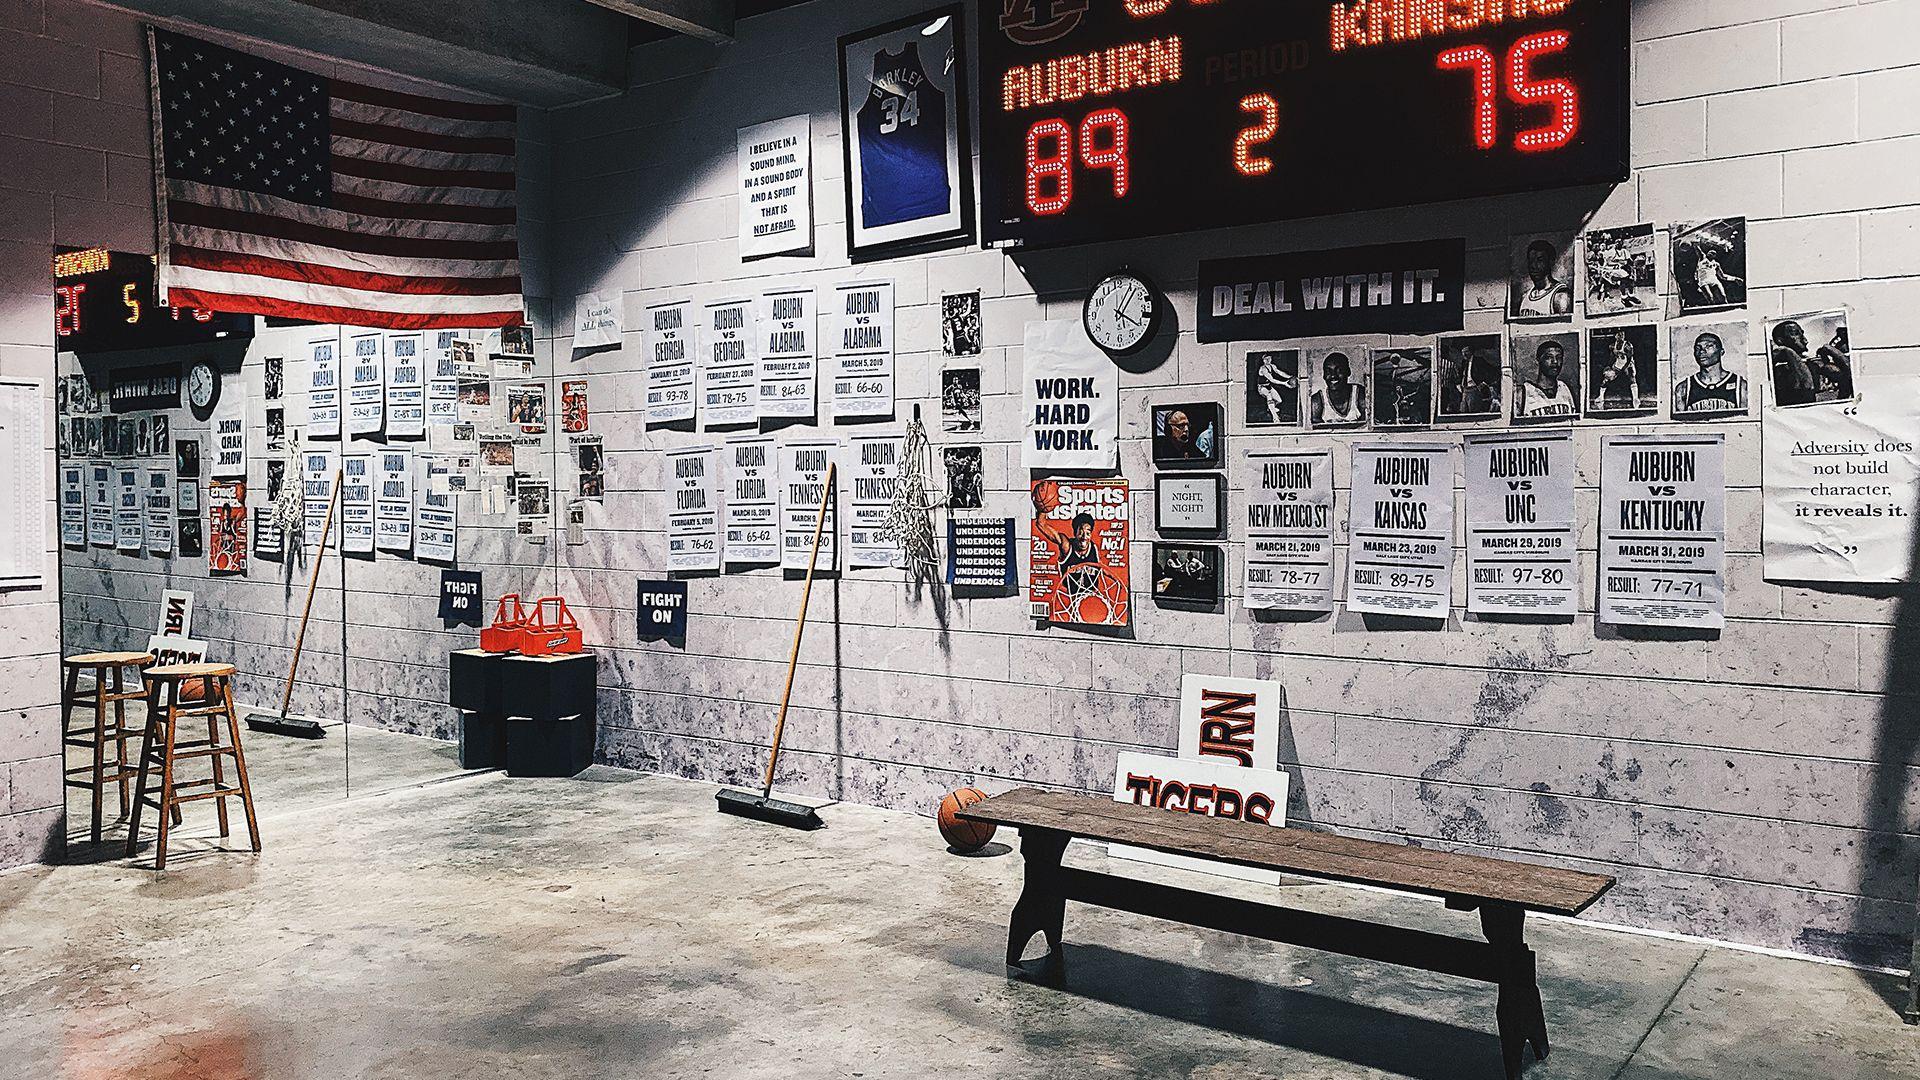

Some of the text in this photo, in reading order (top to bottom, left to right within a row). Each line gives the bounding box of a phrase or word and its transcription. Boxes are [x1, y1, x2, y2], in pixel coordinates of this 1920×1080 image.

[872, 67, 924, 99] BARKLEY
[1002, 35, 1182, 111] AUBURN
[1436, 30, 1579, 153] 75
[880, 90, 920, 134] 34
[1233, 92, 1279, 176] 2
[753, 140, 782, 155] BELIEVE
[783, 138, 791, 148] IN
[792, 136, 798, 146] A
[750, 158, 775, 171] SOUND
[1026, 107, 1130, 215] 89
[745, 178, 752, 188] IN
[760, 173, 785, 186] SOUND
[785, 168, 804, 180] BODY
[751, 192, 766, 203] AND
[774, 186, 796, 199] SPIRIT
[761, 204, 788, 217] THAT IS
[753, 219, 796, 235] NOT AFRAID.
[846, 291, 880, 315] AUBURN
[1212, 268, 1445, 317] DEAL WITH IT.
[714, 307, 743, 330] AUBURN
[772, 297, 803, 320] AUBURN
[655, 308, 682, 331] AUBURN
[769, 331, 805, 353] ALABAMA
[843, 326, 882, 349] ALABAMA
[655, 339, 685, 362] GEORGIA
[713, 340, 745, 363] GEORGIA
[797, 361, 810, 369] 2019
[842, 358, 883, 368] MARCH 5, 2019
[856, 382, 883, 394] 66-60
[1035, 377, 1100, 400] WORK.
[1035, 404, 1090, 425] HARD
[1034, 429, 1099, 451] WORK.
[1790, 438, 1913, 457] Adversity does
[735, 446, 765, 467] AUBURN
[795, 450, 827, 471] AUBURN
[861, 443, 895, 466] AUBURN
[1489, 446, 1549, 477] AUBURN
[676, 457, 704, 479] AUBURN
[1262, 462, 1312, 489] AUBURN
[1374, 457, 1430, 486] AUBURN
[1629, 451, 1695, 482] AUBURN
[1813, 461, 1889, 475] not build
[676, 488, 706, 510] FLORIDA
[736, 478, 766, 500] FLORIDA
[1058, 485, 1125, 505] Sports
[1172, 492, 1203, 502] NIGHT,
[1810, 482, 1892, 497] character,
[791, 514, 812, 522] MARCH
[856, 510, 878, 518] MARCH
[1171, 504, 1203, 513] NIGHT!
[1248, 504, 1329, 528] NEW MEXICO ST
[1374, 501, 1427, 530] KANSAS
[1505, 493, 1536, 524] UNC
[1620, 500, 1706, 531] KENTUCKY
[1795, 504, 1908, 517] it reveals it.
[691, 539, 713, 550] 76-62
[746, 530, 770, 542] 65-62
[1034, 541, 1047, 551] 20
[1482, 537, 1562, 548] MARCH 29, 2019
[1255, 542, 1320, 552] MARCH 21, 2019
[1363, 541, 1436, 554] MARCH 23, 2019
[1619, 545, 1704, 558] MARCH 31, 2019
[953, 577, 1005, 586] UNDERDOGS
[955, 567, 1006, 576] UNDERDOGS
[1248, 569, 1320, 584] RESULT: 78-77
[1354, 569, 1434, 588] RESULT: 89-75
[1474, 567, 1563, 584] RESULT: 97-80
[1607, 576, 1703, 597] RESULT: 77-71
[642, 592, 682, 608] FIGHT
[652, 609, 672, 624] ON
